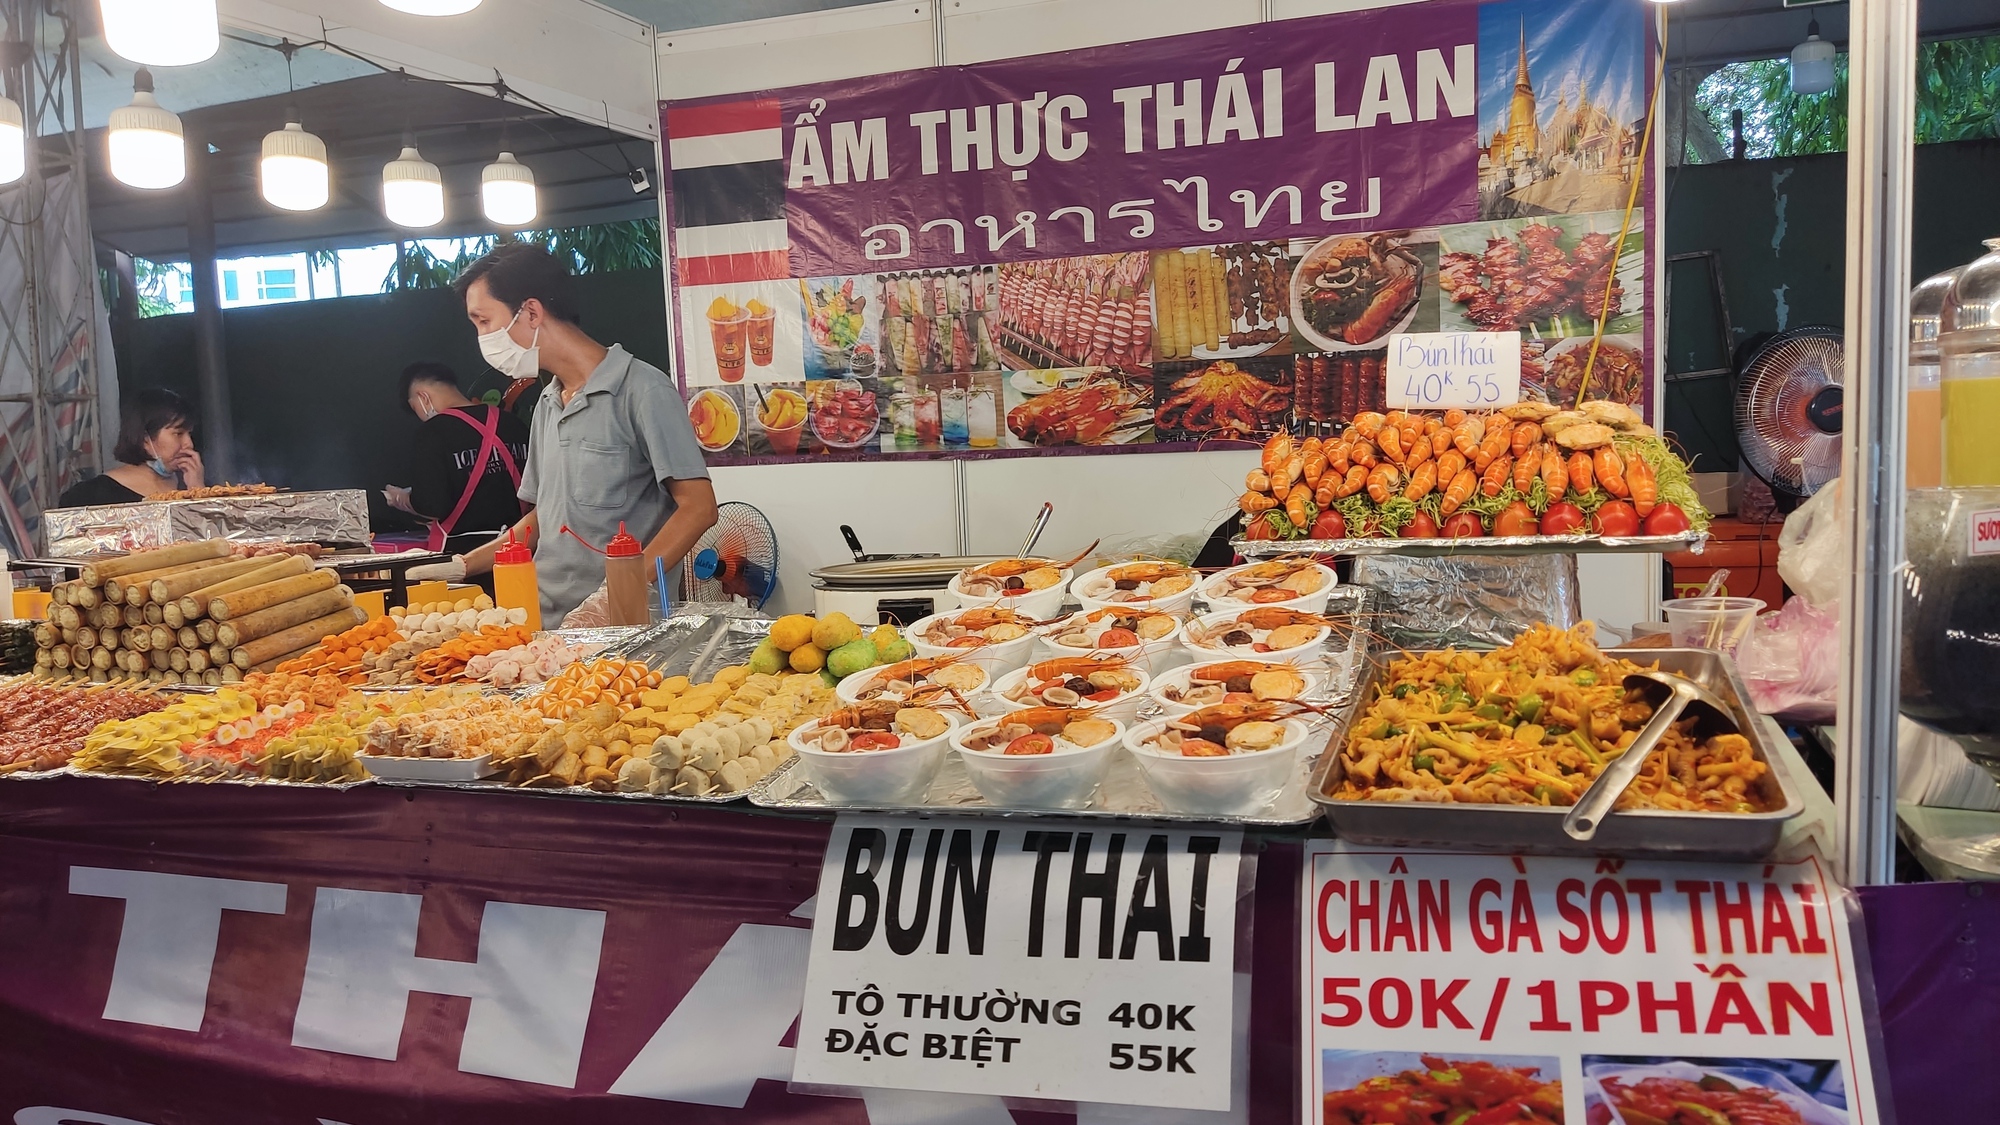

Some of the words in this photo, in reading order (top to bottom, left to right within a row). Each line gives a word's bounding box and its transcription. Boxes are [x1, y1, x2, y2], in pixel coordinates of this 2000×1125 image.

[788, 98, 890, 190] ẨM
[910, 91, 1088, 181] THỰC
[1113, 58, 1284, 154] THÁI
[1314, 43, 1476, 133] LAN
[859, 175, 1382, 262] อาหารไทย
[1398, 336, 1449, 370] Bún
[1446, 333, 1496, 367] Thái
[1317, 856, 1451, 955] CHÂN
[1468, 855, 1543, 956] GÀ
[1558, 857, 1662, 956] SỐT
[1675, 864, 1828, 955] THÁI
[831, 983, 885, 1018] TÔ
[897, 988, 1082, 1027] THƯỜNG
[1108, 1002, 1197, 1032] 40K
[824, 1022, 909, 1062] ĐẶC
[922, 1027, 1021, 1069] BIỆT
[1108, 1043, 1197, 1075] 55K
